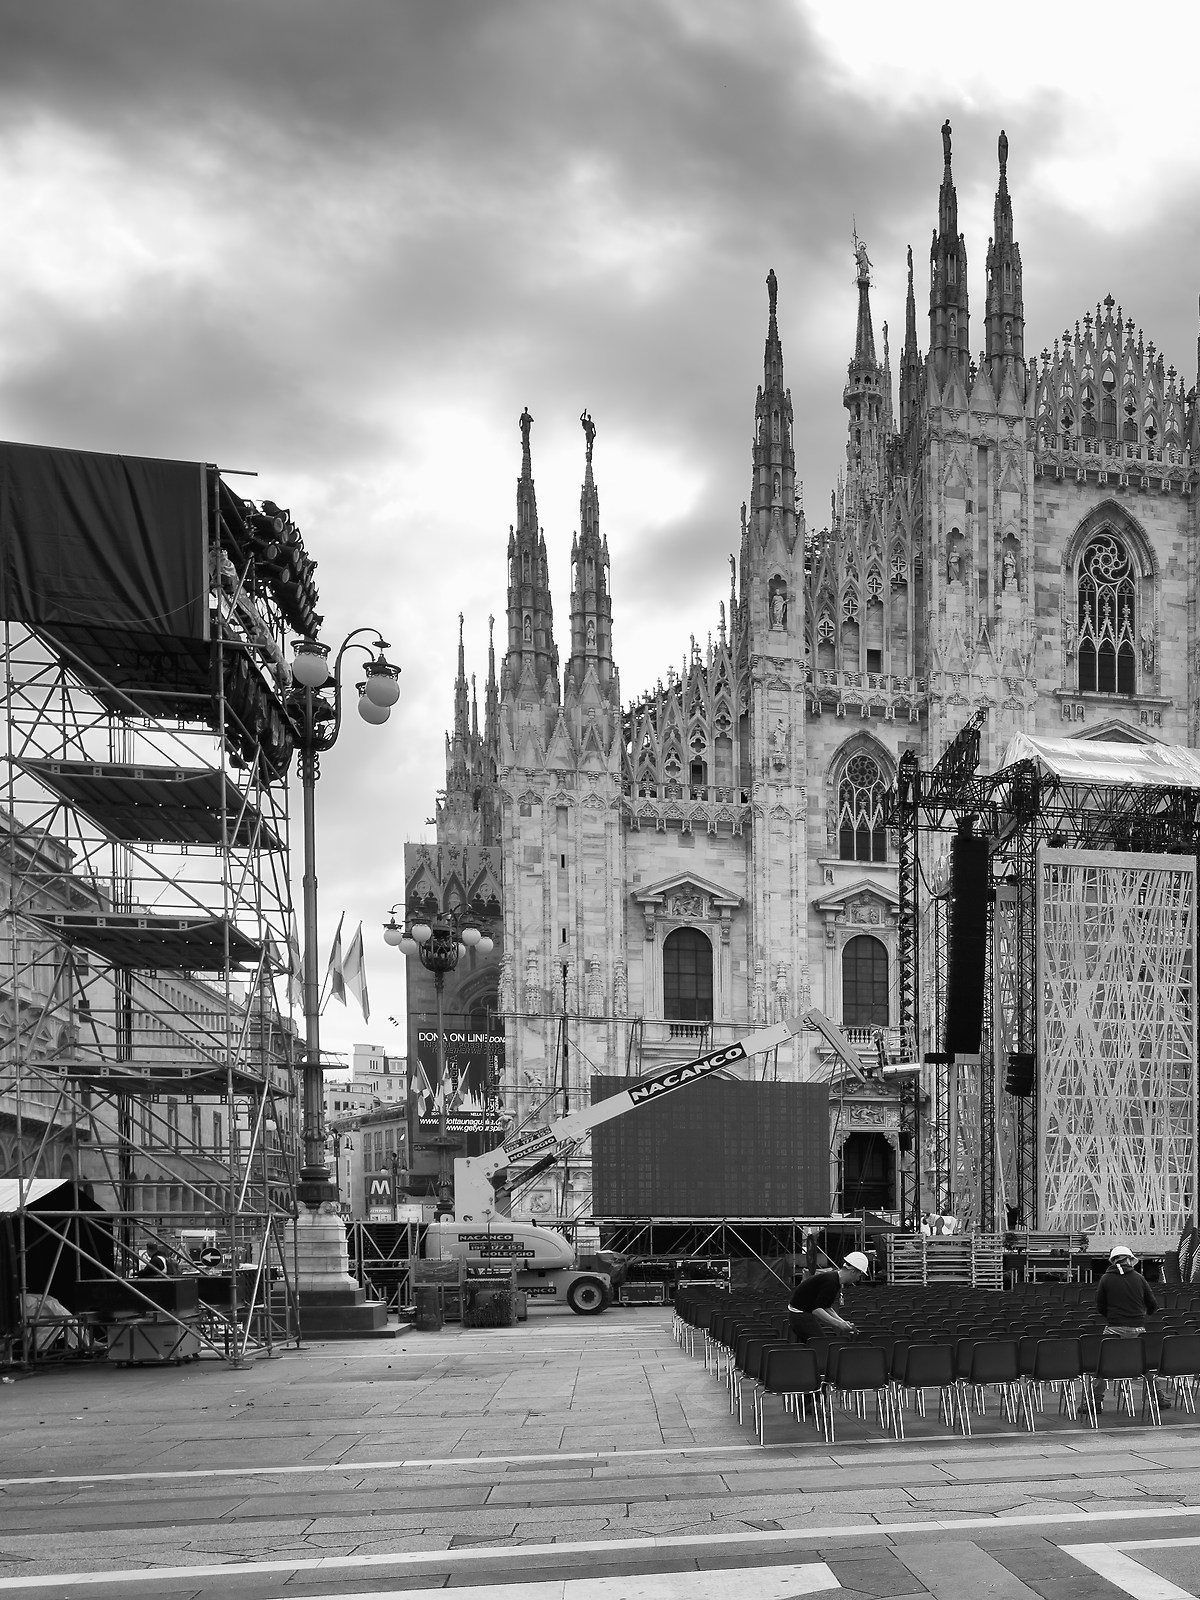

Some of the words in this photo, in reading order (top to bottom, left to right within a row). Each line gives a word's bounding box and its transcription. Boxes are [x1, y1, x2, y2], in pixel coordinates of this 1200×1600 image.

[449, 1032, 465, 1042] ON
[467, 1033, 488, 1043] LINE
[631, 1047, 743, 1101] NACANCO
[510, 1138, 555, 1161] NOLEGGIO
[370, 1180, 391, 1195] M
